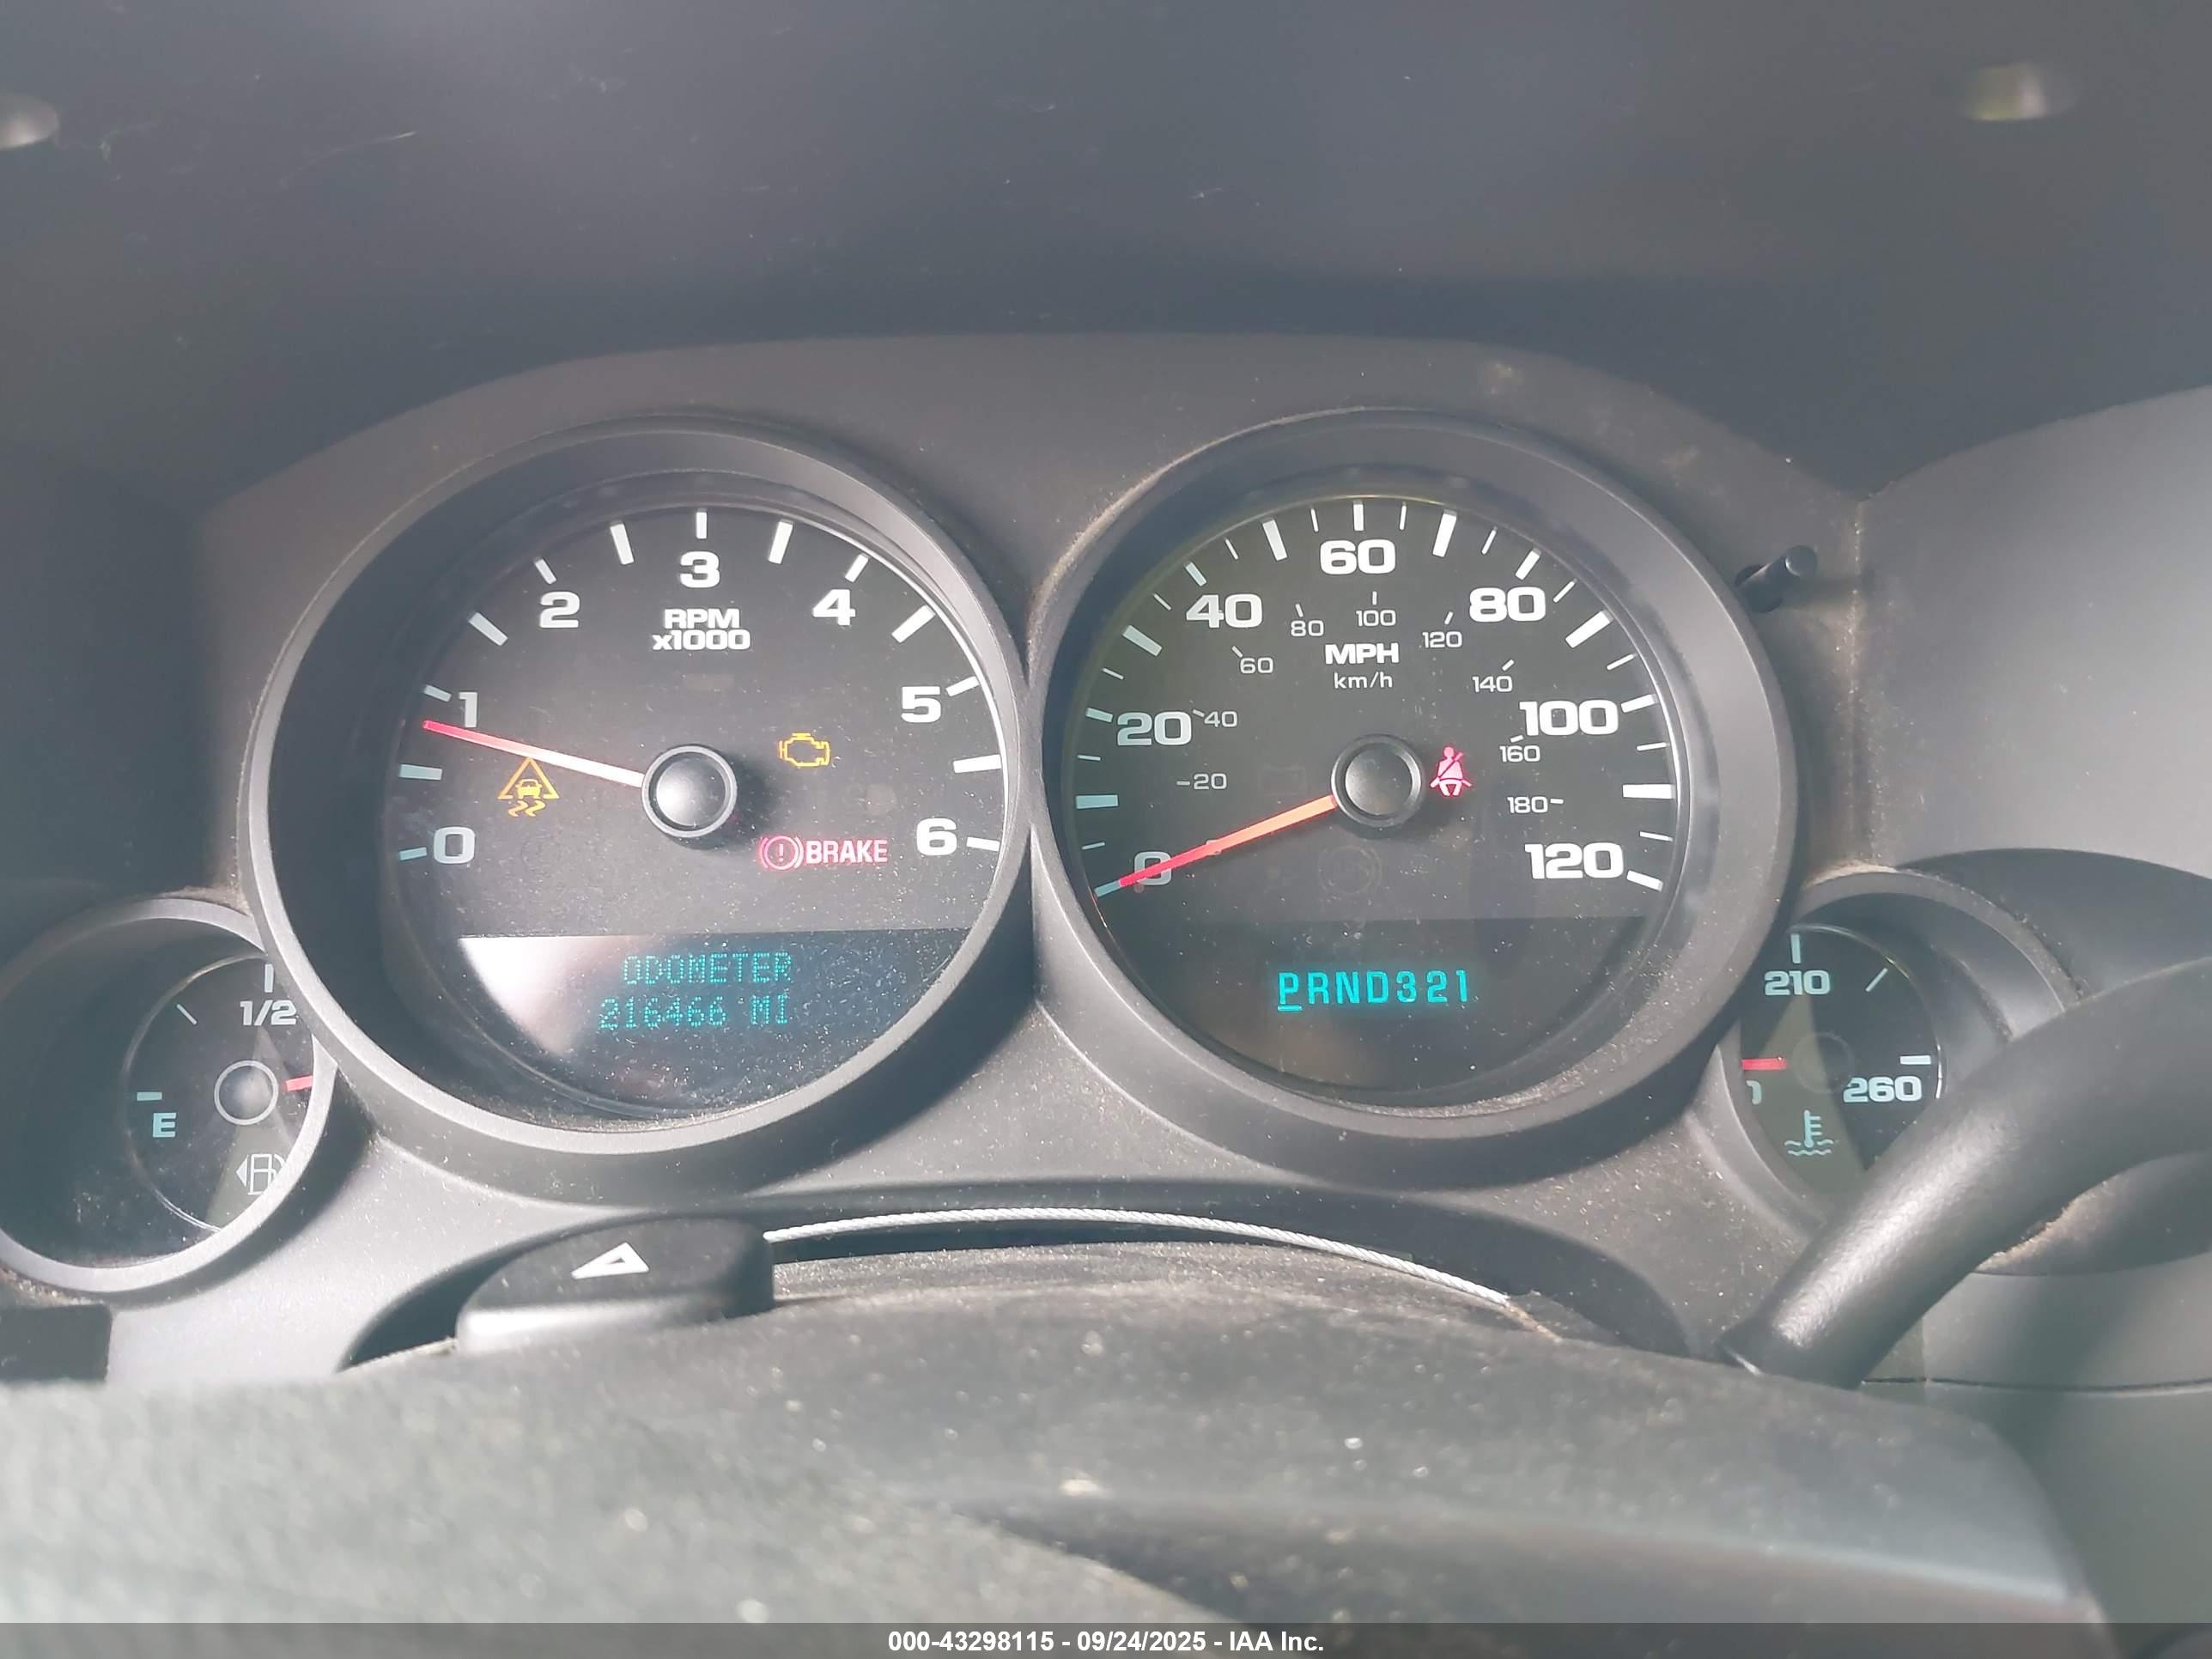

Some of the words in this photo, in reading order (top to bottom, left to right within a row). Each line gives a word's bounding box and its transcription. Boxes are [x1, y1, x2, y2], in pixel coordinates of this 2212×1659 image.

[681, 552, 720, 587] 3
[1320, 539, 1396, 574] 60
[539, 592, 580, 629] 2
[813, 589, 855, 625] 4
[1186, 594, 1262, 628] 40
[1469, 587, 1546, 622] 80
[665, 609, 739, 629] RPM
[1291, 620, 1324, 637] 80
[1357, 610, 1396, 627] 100
[652, 629, 750, 651] x1000
[1423, 631, 1462, 648] 120
[1240, 657, 1273, 674] 60
[1325, 643, 1400, 664] MPH
[1334, 671, 1393, 690] km/h
[1473, 676, 1513, 693] 140
[459, 692, 477, 727] 1
[902, 687, 941, 722] 5
[1117, 712, 1193, 746] 20
[1204, 711, 1237, 728] 40
[1520, 700, 1618, 736] 100
[1500, 745, 1540, 763] 160
[1194, 773, 1227, 789] 20
[1507, 797, 1547, 814] 180
[434, 827, 475, 864] 0
[917, 817, 957, 855] 6
[805, 839, 888, 864] BRAKE
[1525, 842, 1624, 878] 120
[1134, 851, 1172, 885] 0
[623, 952, 792, 984] ODOMETER
[1765, 970, 1831, 995] 210
[240, 1000, 297, 1026] 1/2
[600, 996, 727, 1028] 216466
[750, 994, 788, 1024] MI
[1844, 1076, 1922, 1103] 260
[153, 1112, 177, 1138] E
